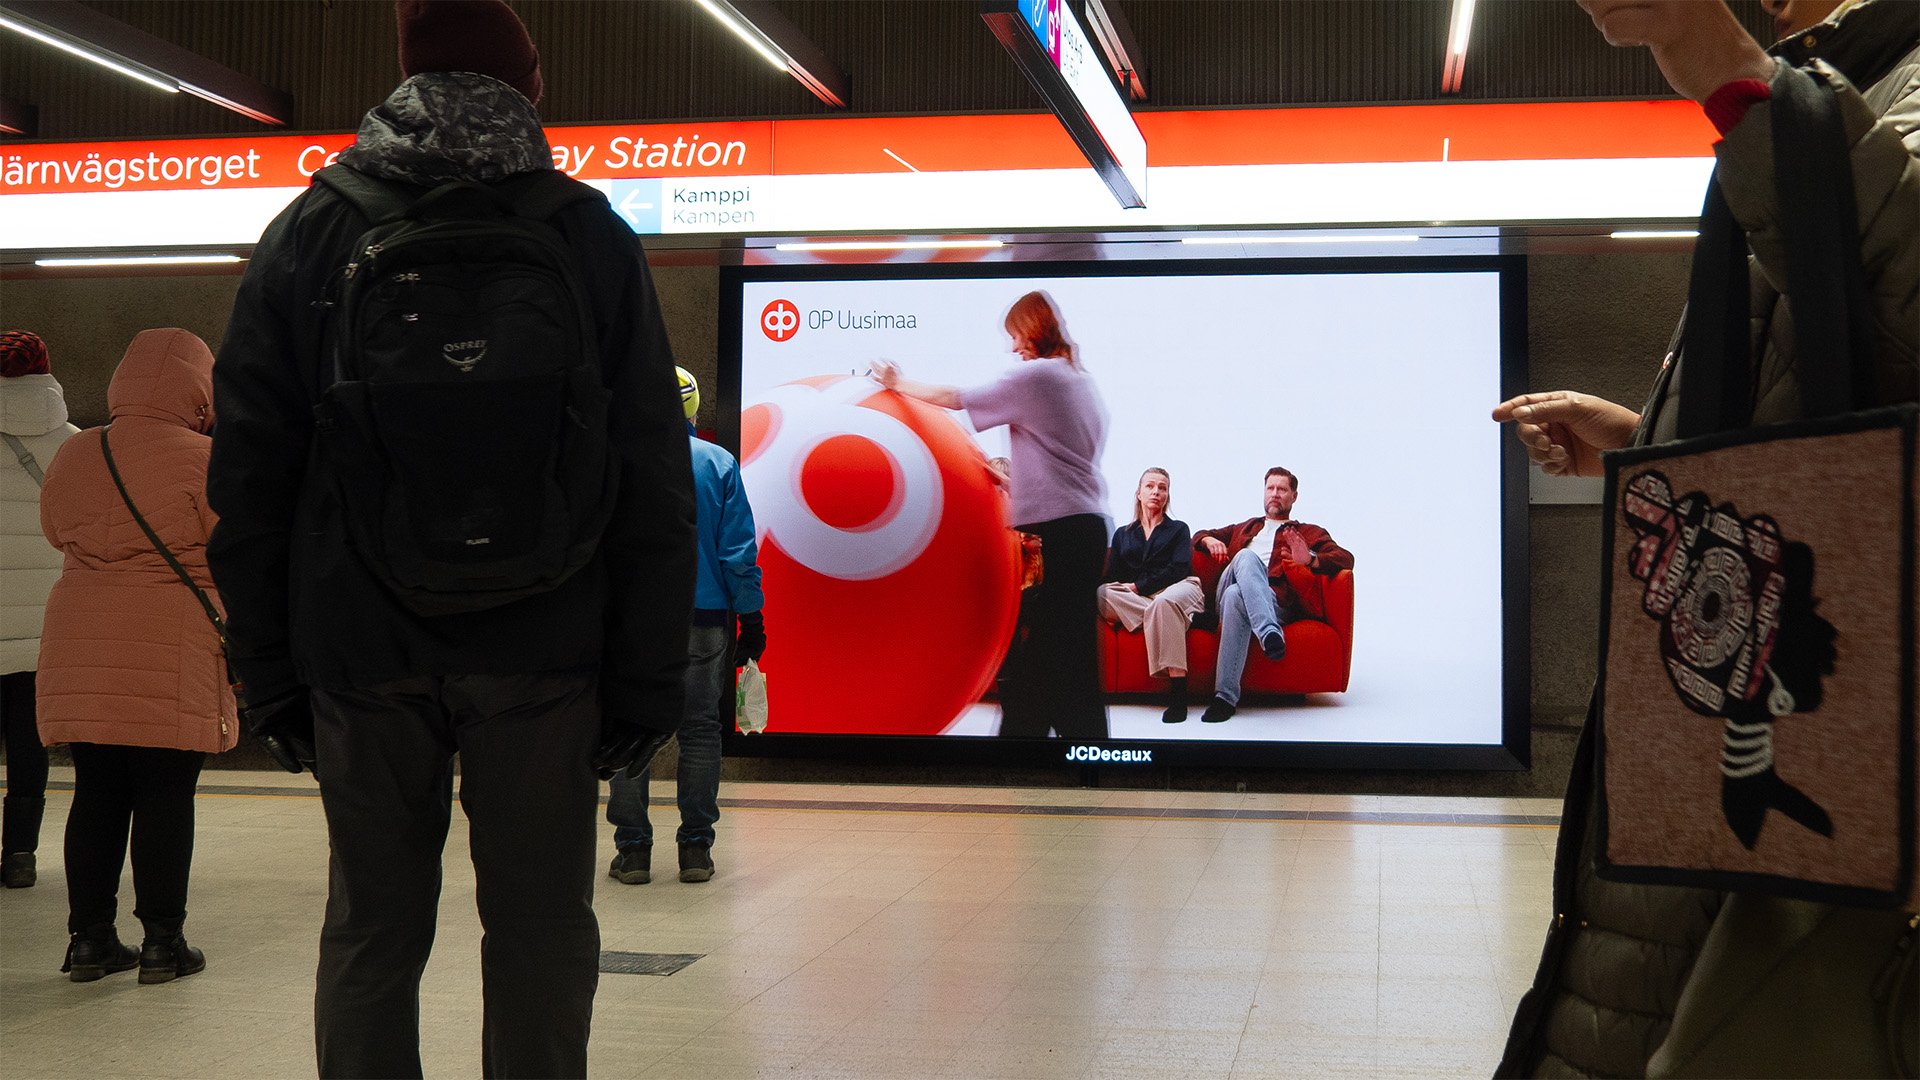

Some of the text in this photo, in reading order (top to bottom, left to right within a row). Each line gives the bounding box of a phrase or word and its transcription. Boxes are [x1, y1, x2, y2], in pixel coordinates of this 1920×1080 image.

[604, 134, 747, 169] Station
[673, 186, 751, 205] Kamppi
[672, 208, 756, 227] Kampen
[808, 310, 918, 330] OP Uusimaa
[1065, 745, 1153, 762] JCDecaux
